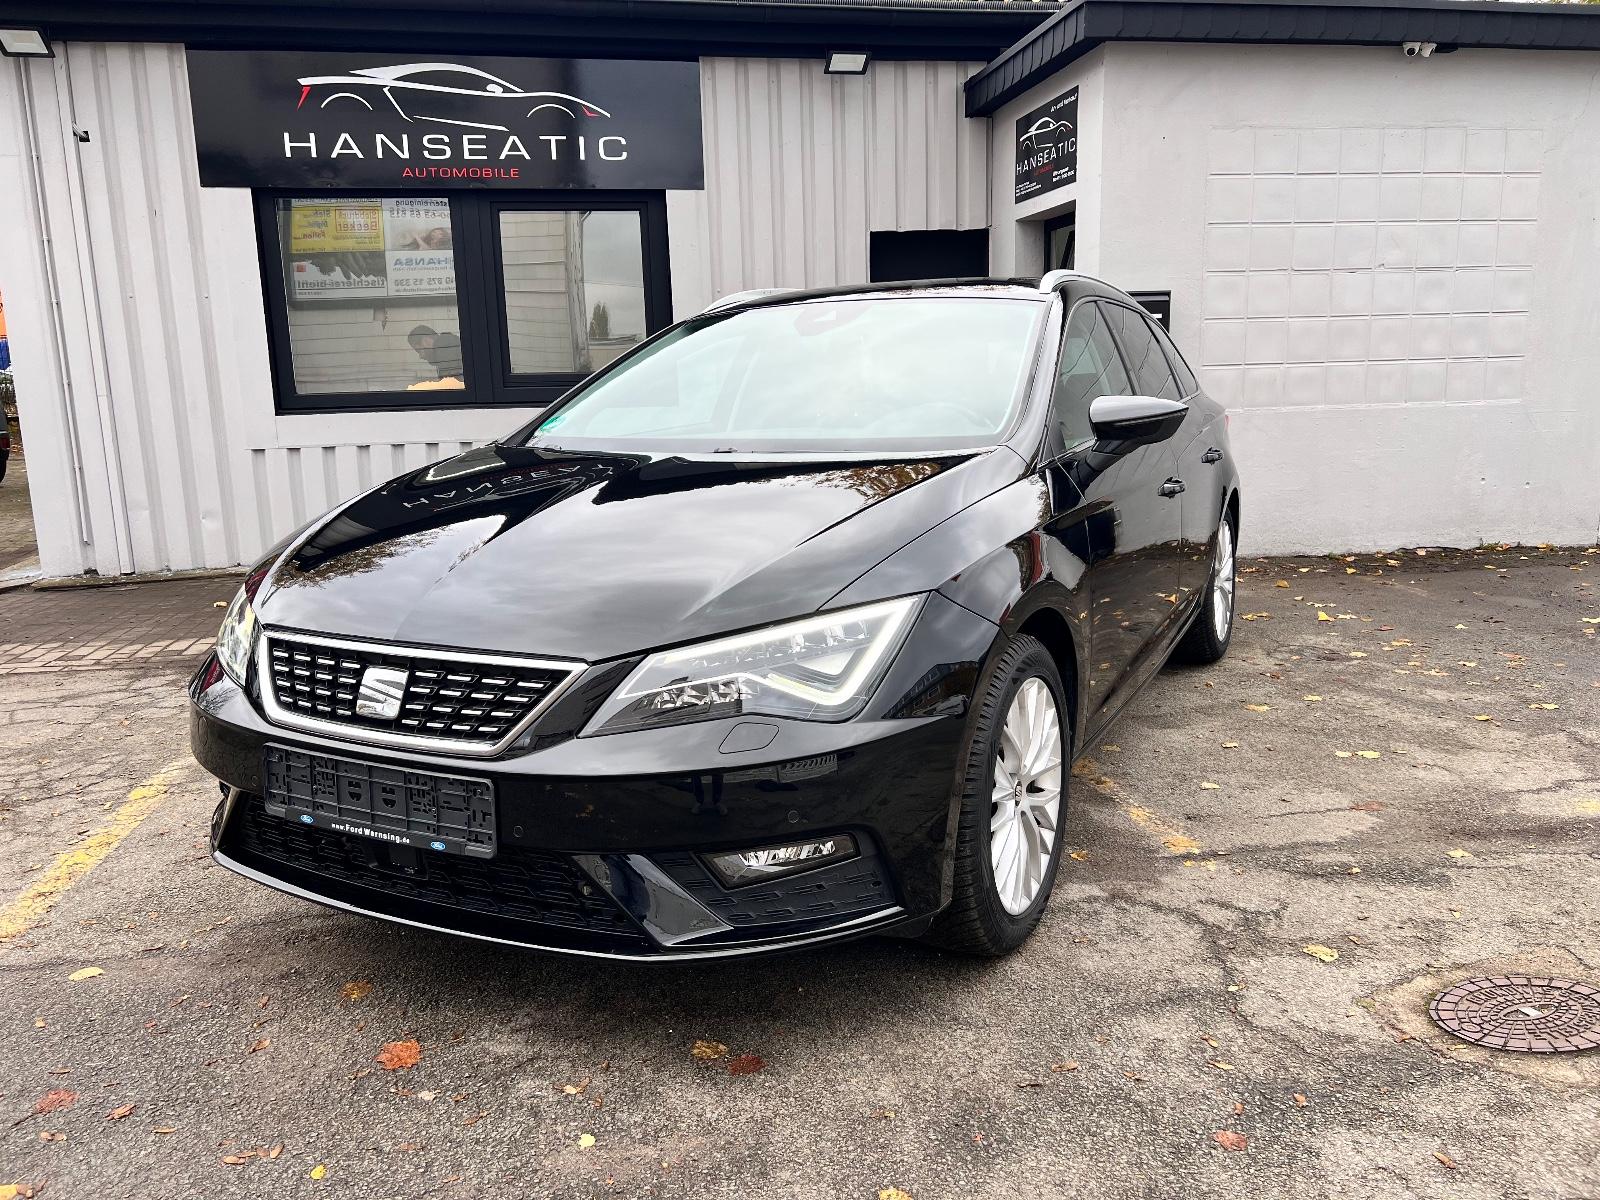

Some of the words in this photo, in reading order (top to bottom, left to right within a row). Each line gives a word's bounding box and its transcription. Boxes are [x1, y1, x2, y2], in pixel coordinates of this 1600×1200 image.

[283, 131, 628, 161] HANSEATIC
[1015, 137, 1077, 176] HANSEATIC
[402, 166, 520, 179] AUTOMOBILE
